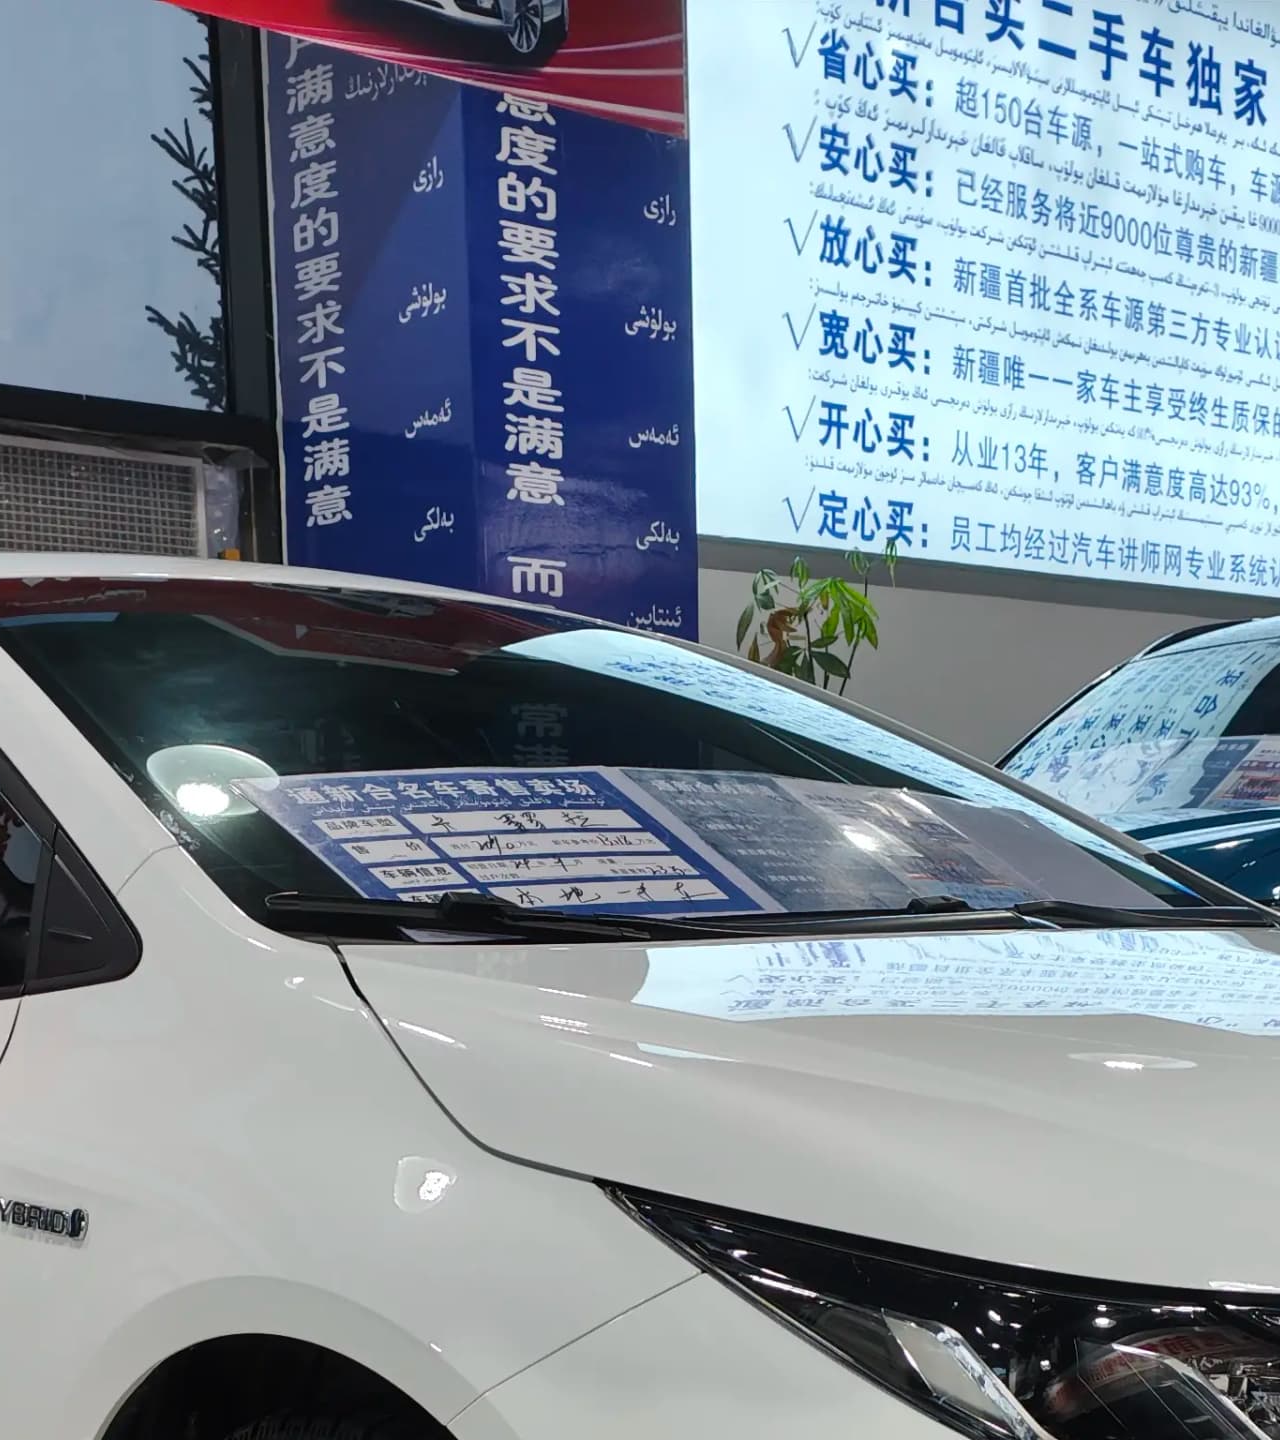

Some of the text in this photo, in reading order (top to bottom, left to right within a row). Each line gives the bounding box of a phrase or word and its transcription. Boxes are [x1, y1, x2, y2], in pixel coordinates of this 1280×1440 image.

[819, 27, 934, 107] 省心买：
[819, 123, 933, 198] 安心买：
[819, 213, 932, 287] 放心买：
[818, 309, 931, 375] 宽心买：
[818, 401, 930, 461] 开心买：
[817, 490, 928, 548] 定心买：
[507, 555, 567, 598] 而
